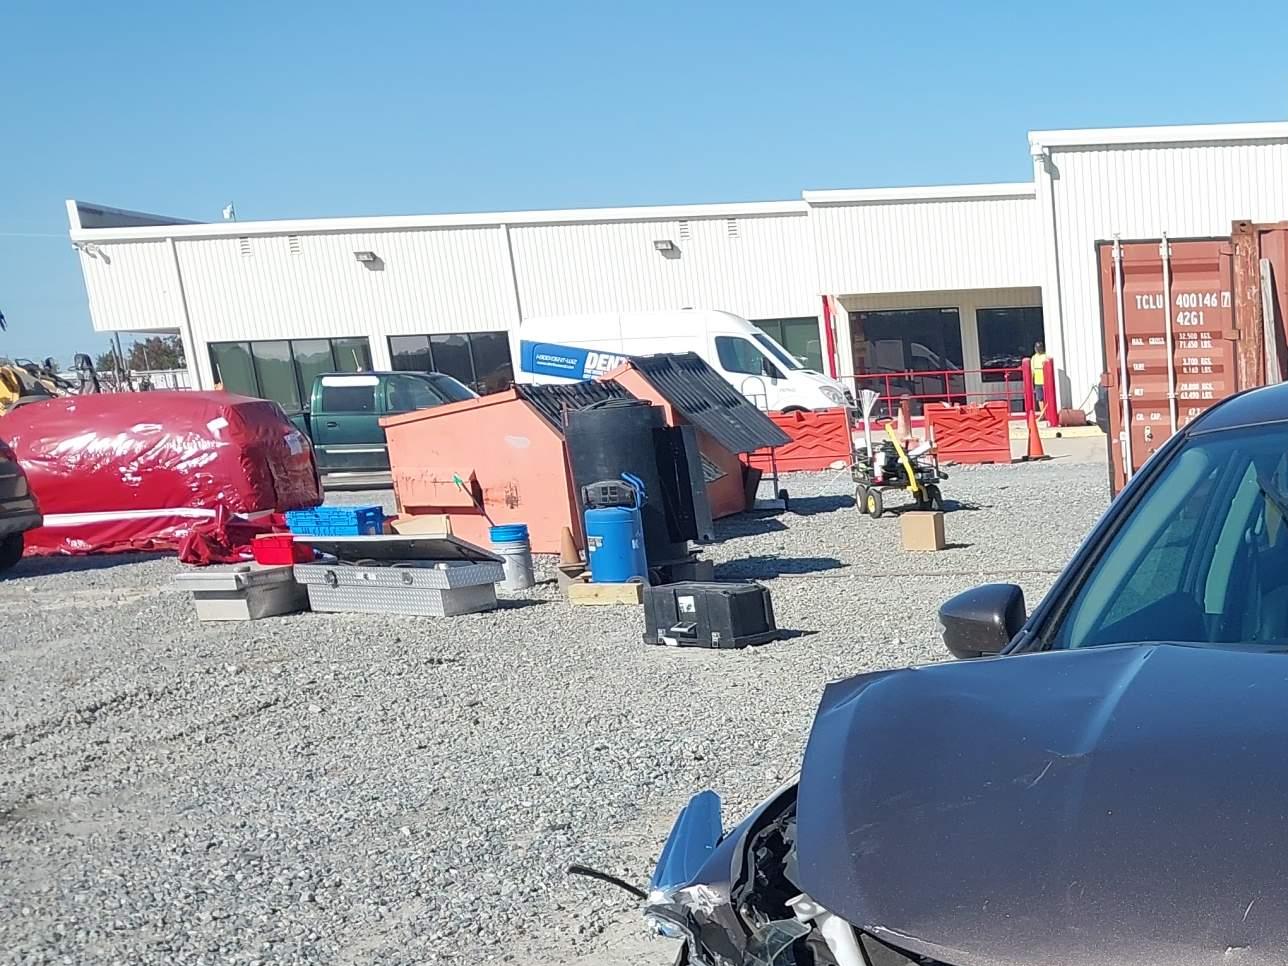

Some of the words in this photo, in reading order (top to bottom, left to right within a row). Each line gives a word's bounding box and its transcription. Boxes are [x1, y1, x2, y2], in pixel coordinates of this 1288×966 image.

[1136, 294, 1163, 309] TCLU
[1176, 292, 1218, 308] 400146
[1177, 310, 1204, 326] 42G1
